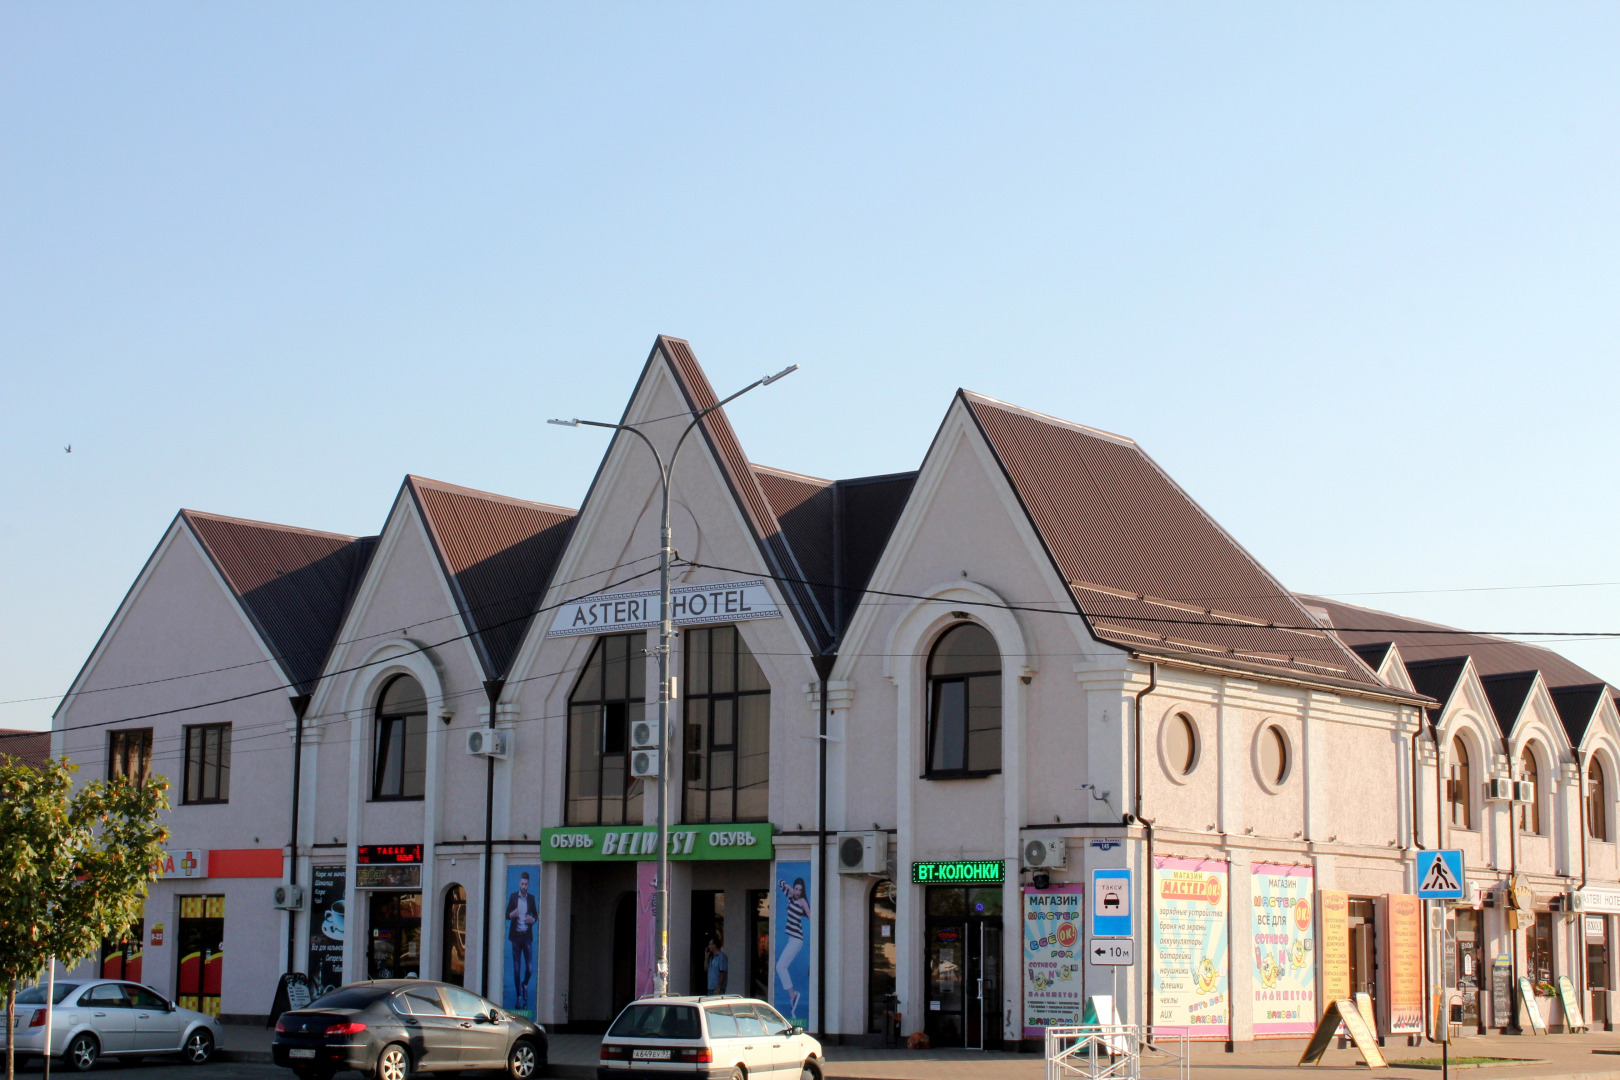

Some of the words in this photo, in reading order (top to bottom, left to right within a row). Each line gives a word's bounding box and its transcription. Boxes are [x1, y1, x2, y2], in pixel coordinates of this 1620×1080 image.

[572, 599, 647, 627] ASTERI
[672, 590, 752, 618] HOTEL
[550, 834, 594, 848] ОБУВЬ
[709, 831, 756, 846] ОБУВЬ
[377, 847, 406, 855] ТАБАК
[918, 864, 999, 880] ВТ-КОЛОНКИ
[1173, 872, 1203, 880] МАГАЗИН
[1163, 881, 1205, 895] МАСТЕР
[1269, 879, 1297, 888] МАГАЗИН
[1029, 896, 1078, 906] МАГАЗИН
[1254, 895, 1297, 908] МАСТЕР
[1028, 911, 1080, 920] МАСТЕР
[1159, 907, 1188, 917] зарядные
[1188, 909, 1223, 918] устройства
[1159, 921, 1177, 931] броня
[1187, 924, 1207, 932] экраны
[1272, 915, 1287, 927] ДЛЯ
[1586, 921, 1603, 932] ВХОД
[1030, 933, 1057, 951] ВСЁ
[1159, 938, 1203, 947] аккумуляторы
[1255, 933, 1289, 945] СОТИКОВ
[1051, 950, 1074, 958] FOR
[1159, 951, 1192, 961] батарейки
[1159, 968, 1189, 976] наушники
[1159, 981, 1184, 991] флешки
[1254, 990, 1313, 1001] ПЛАНШЕТОВ
[1160, 1011, 1173, 1019] AUX
